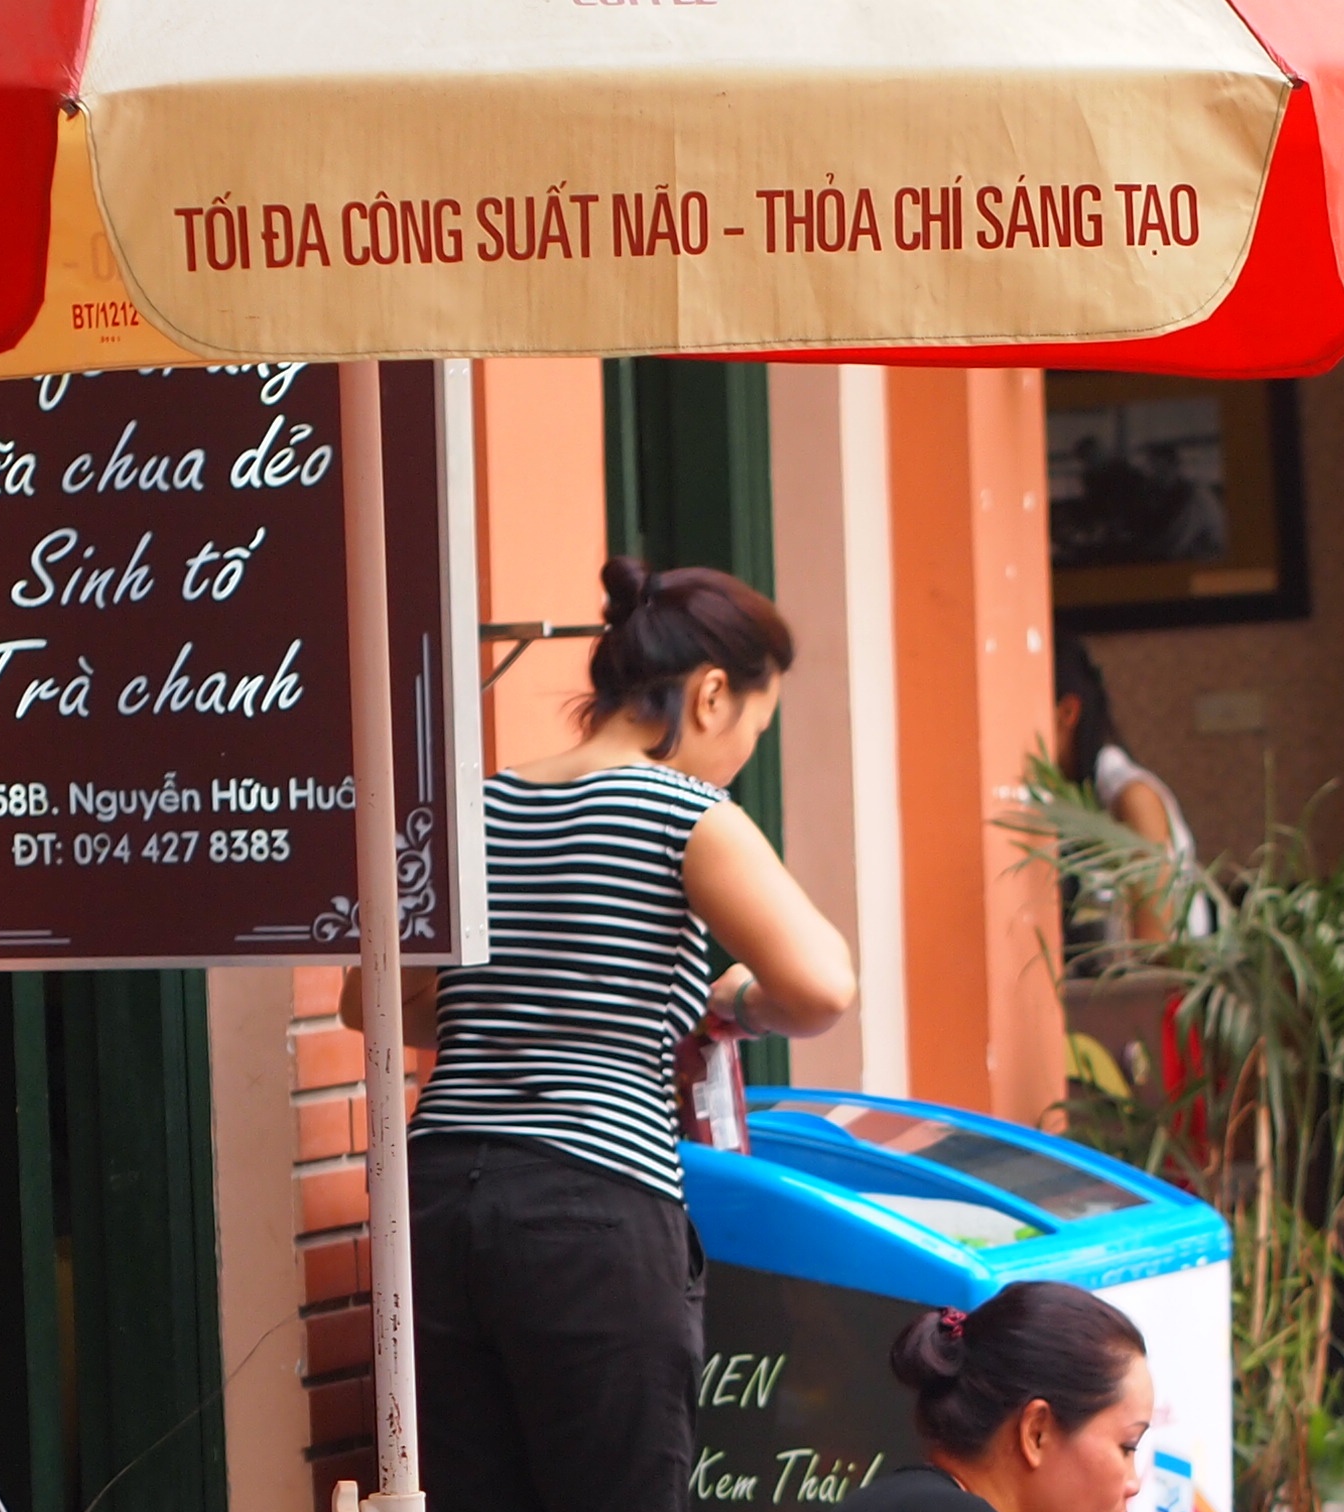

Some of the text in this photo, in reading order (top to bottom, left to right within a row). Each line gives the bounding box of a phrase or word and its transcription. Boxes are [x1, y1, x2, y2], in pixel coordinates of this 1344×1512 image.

[174, 191, 251, 271] TỐI
[261, 203, 331, 268] ĐA
[342, 191, 464, 266] CÔNG
[476, 180, 599, 261] SUẤT
[612, 183, 709, 257] NÃO
[756, 173, 882, 254] THỎA
[894, 175, 963, 251] CHÍ
[976, 174, 1104, 249] SÁNG
[1114, 183, 1200, 256] TẠO
[61, 419, 206, 494] chua
[229, 413, 334, 489] dẻo
[10, 526, 268, 608] Sinh tố
[117, 637, 304, 716] chanh
[68, 771, 202, 822] Nguyễn
[211, 777, 280, 812] Hữu
[288, 775, 356, 811] Huâ
[12, 828, 291, 866] ĐT: 094 427 8383
[688, 1446, 759, 1501] Kem
[772, 1448, 856, 1504] Thái
